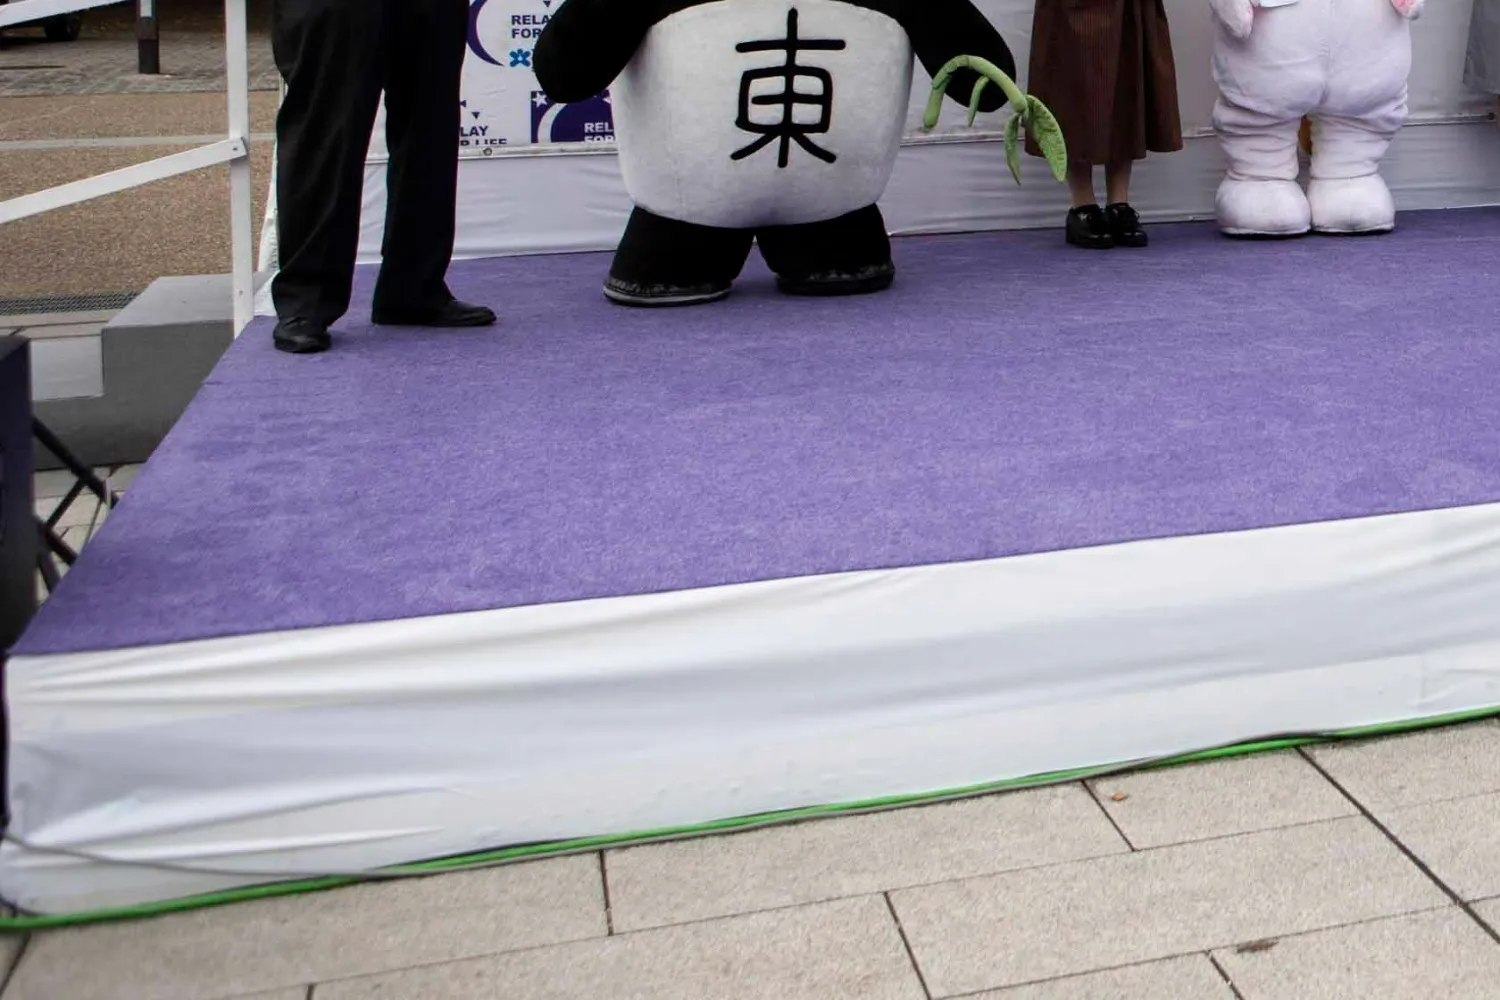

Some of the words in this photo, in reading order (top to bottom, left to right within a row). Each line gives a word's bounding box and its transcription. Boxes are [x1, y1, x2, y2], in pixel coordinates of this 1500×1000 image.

[512, 15, 550, 25] RELA
[512, 29, 542, 38] FOR
[730, 7, 846, 168] 東
[461, 126, 488, 136] LAY
[585, 123, 614, 133] REL
